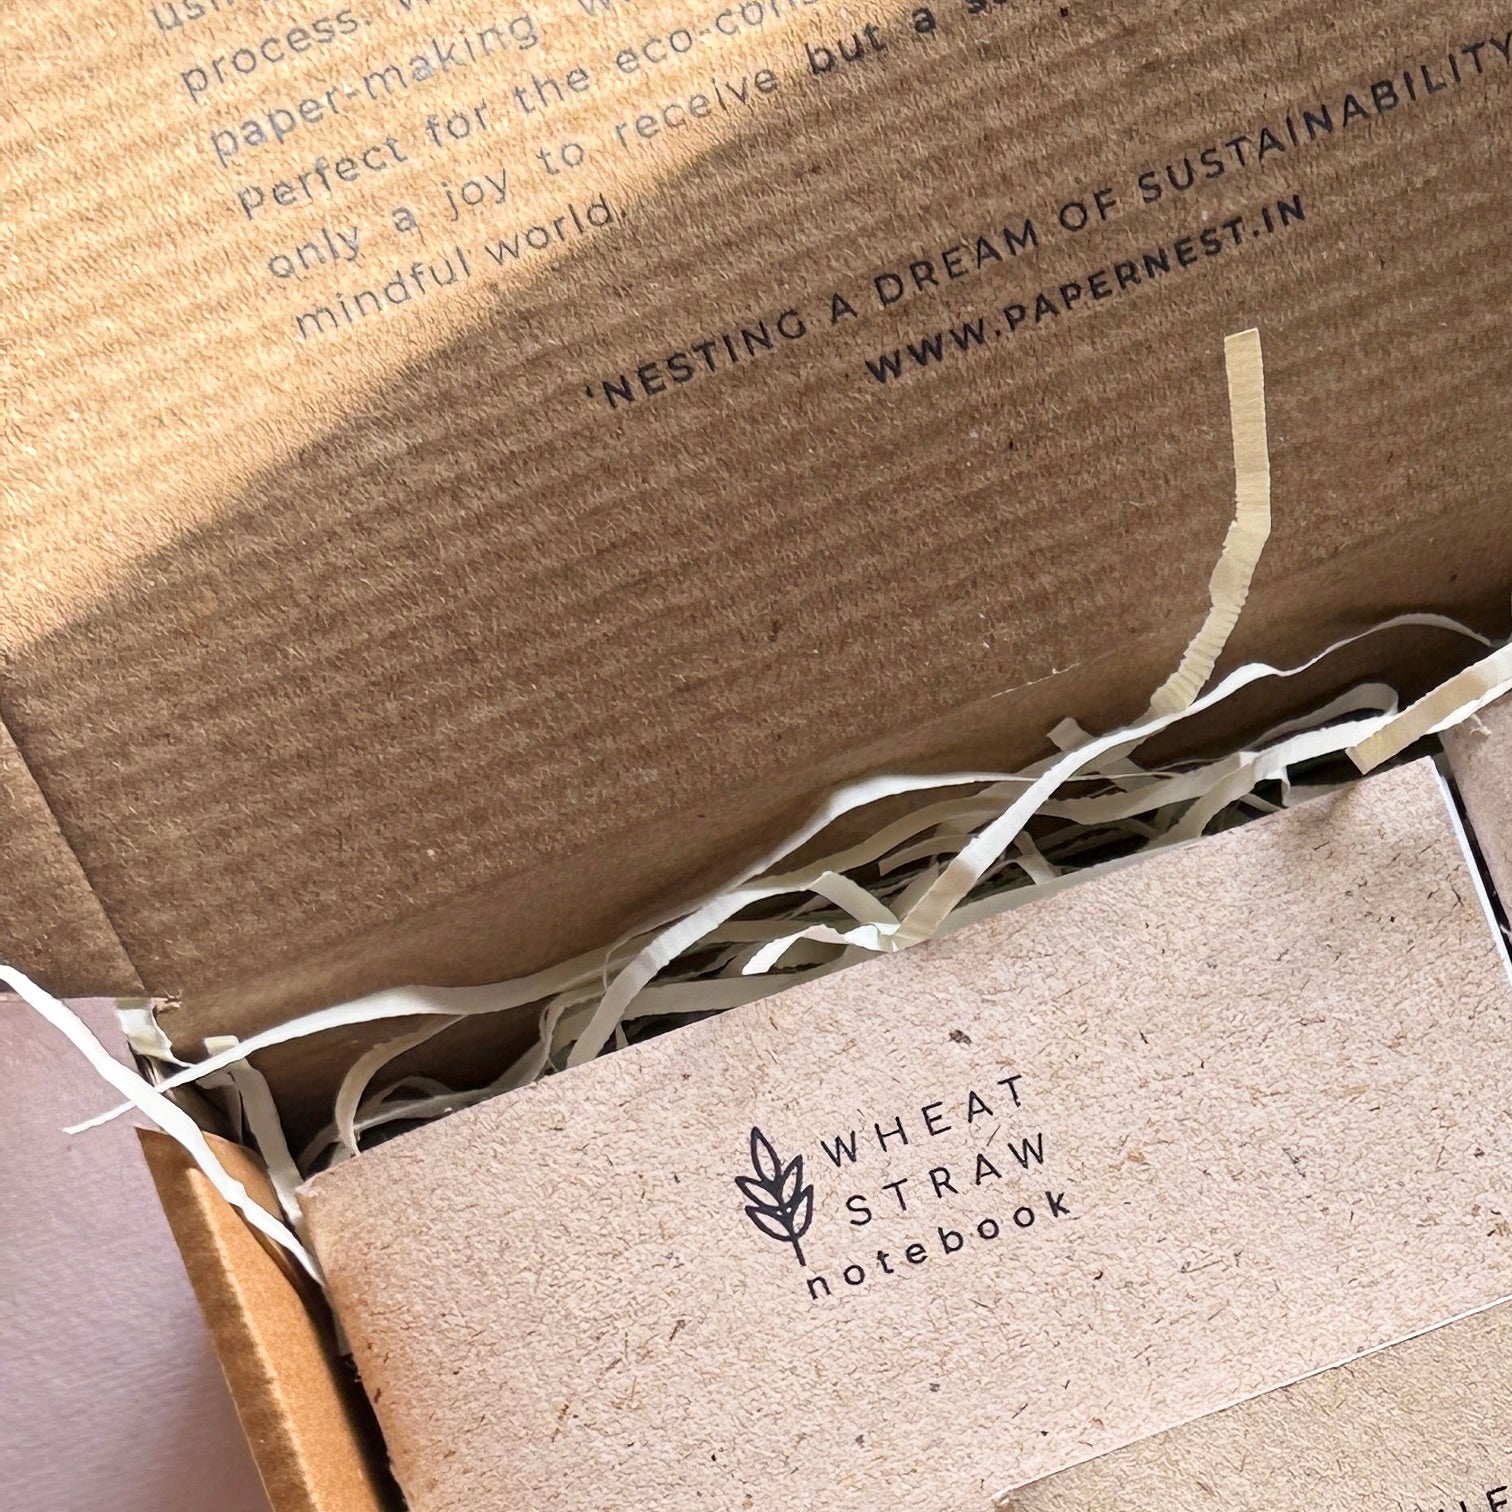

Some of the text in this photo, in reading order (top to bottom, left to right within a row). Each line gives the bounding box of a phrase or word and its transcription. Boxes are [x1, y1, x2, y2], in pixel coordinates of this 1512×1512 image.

[181, 9, 372, 104] process.
[211, 15, 537, 168] paper-making
[238, 136, 408, 220] Perfect
[426, 99, 487, 147] for
[513, 67, 588, 113] the
[268, 7, 937, 278] only a joy to receive but a
[296, 193, 627, 339] mindful world.
[585, 308, 807, 409] 'NESTING
[829, 292, 858, 325] A
[873, 218, 1039, 306] DREAM
[1059, 187, 1118, 232] OF
[864, 195, 1306, 384] WWW.PAPERNEST.IN
[820, 1074, 1023, 1167] WHEAT
[845, 1132, 1043, 1226] STRAW
[806, 1190, 1071, 1300] notebook
